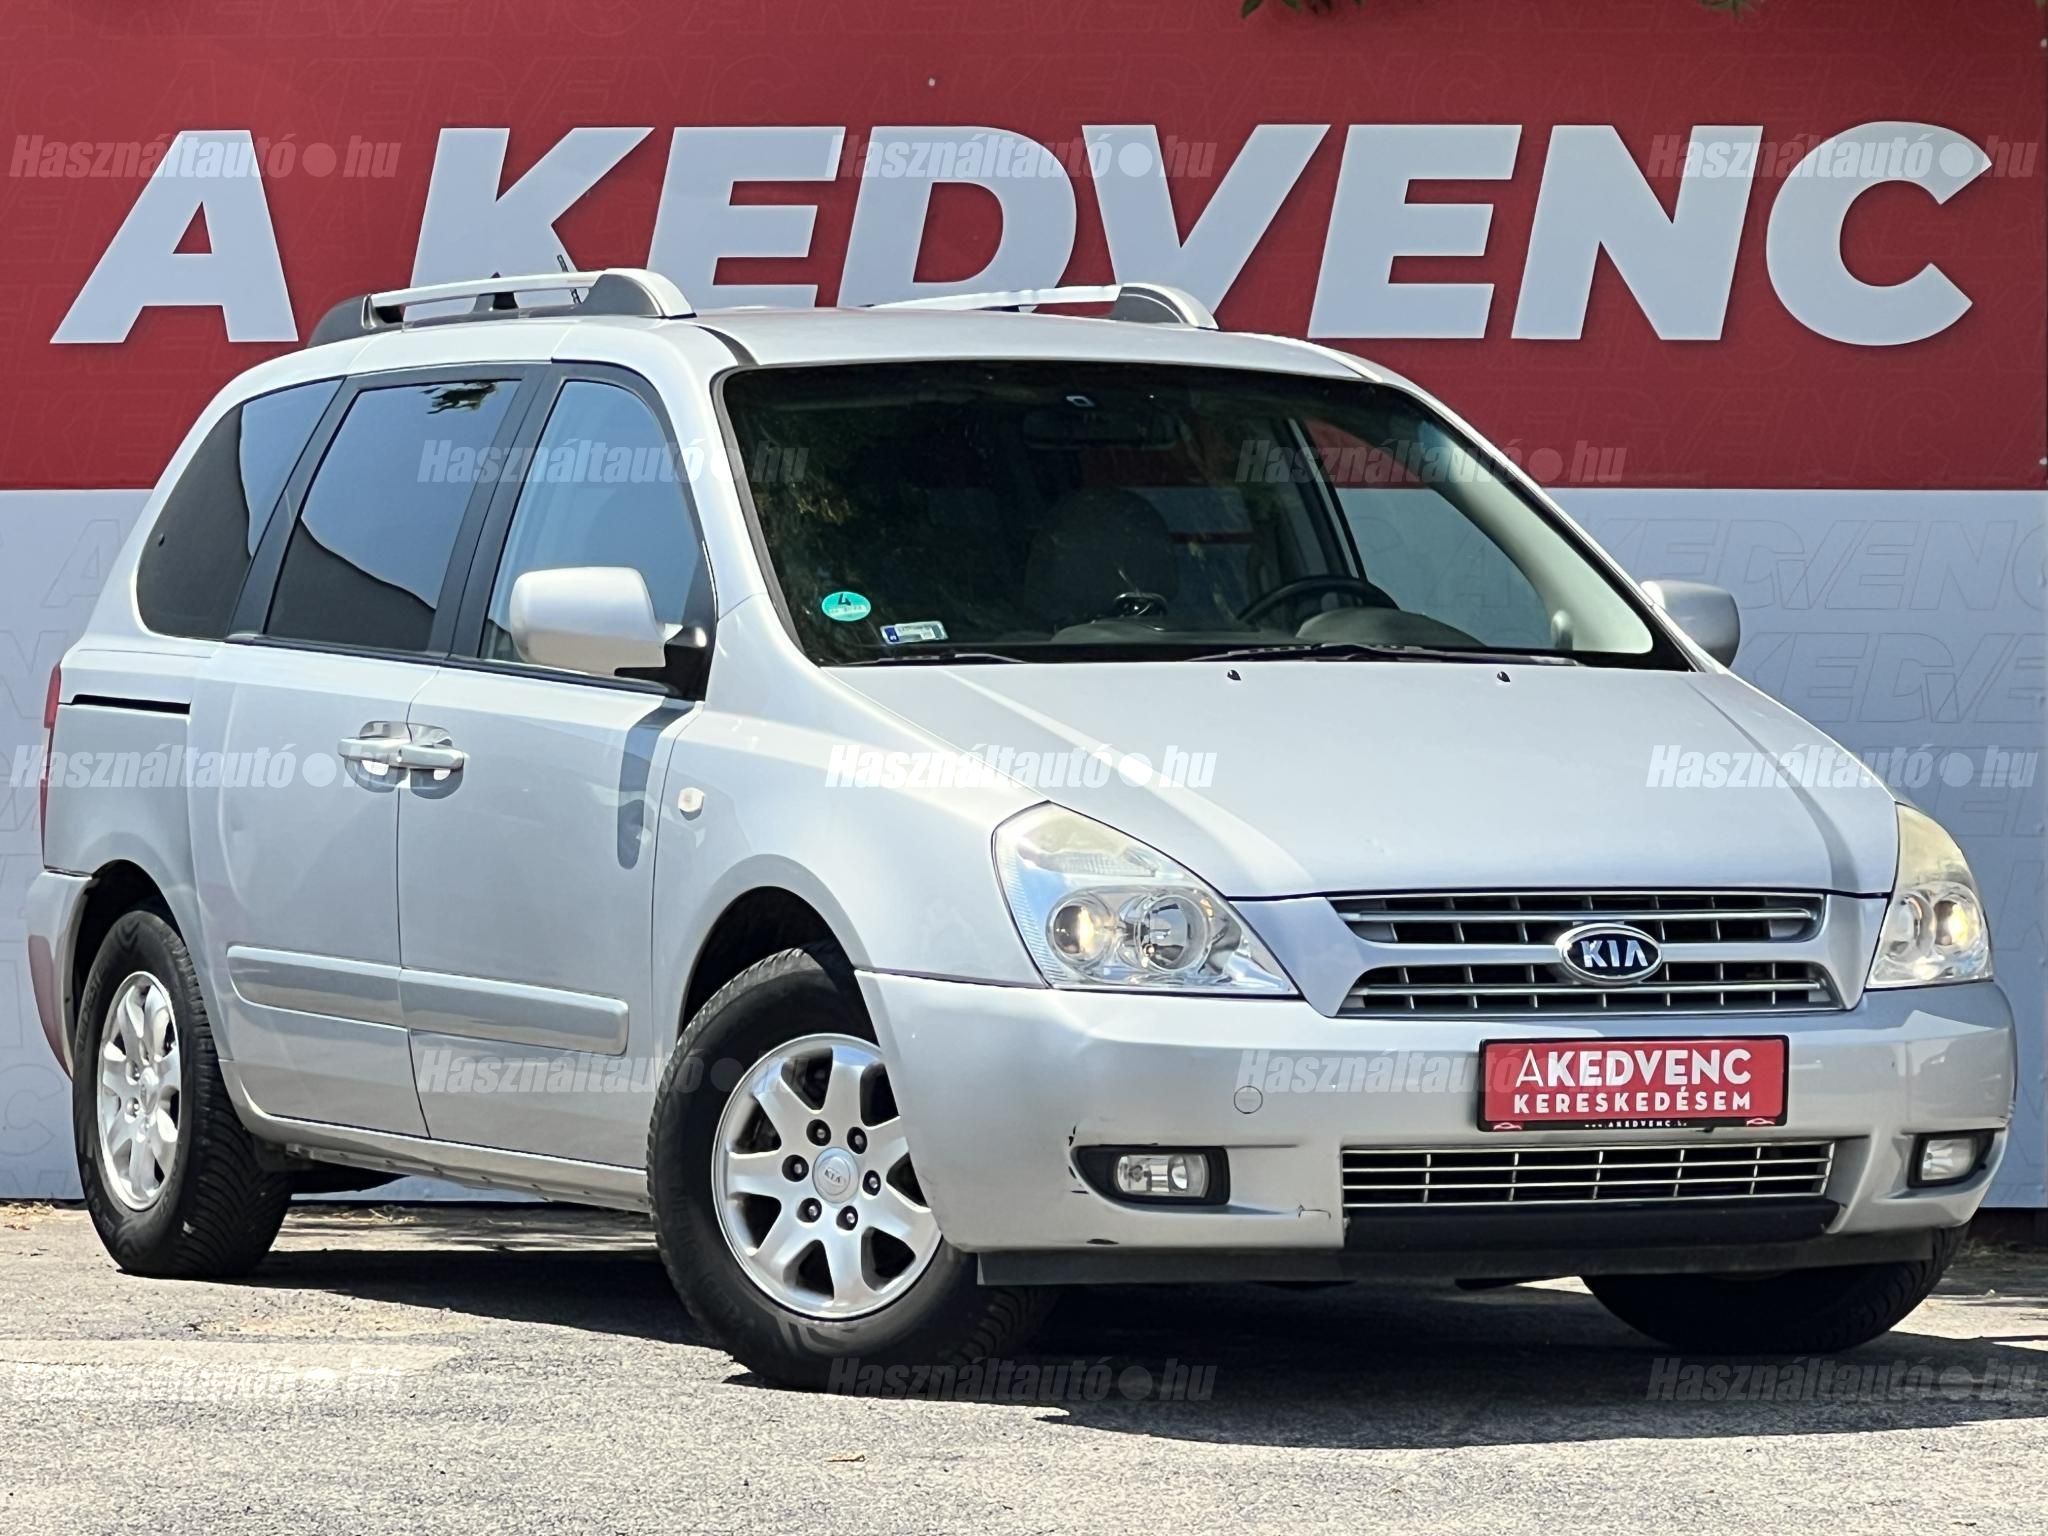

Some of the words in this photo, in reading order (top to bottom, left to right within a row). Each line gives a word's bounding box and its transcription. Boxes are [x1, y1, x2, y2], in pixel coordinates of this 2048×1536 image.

[50, 129, 298, 345] A
[411, 121, 1993, 347] KEDVENC
[1580, 940, 1649, 968] KIA
[1513, 1087, 1750, 1114] KERESKEDÉSEM
